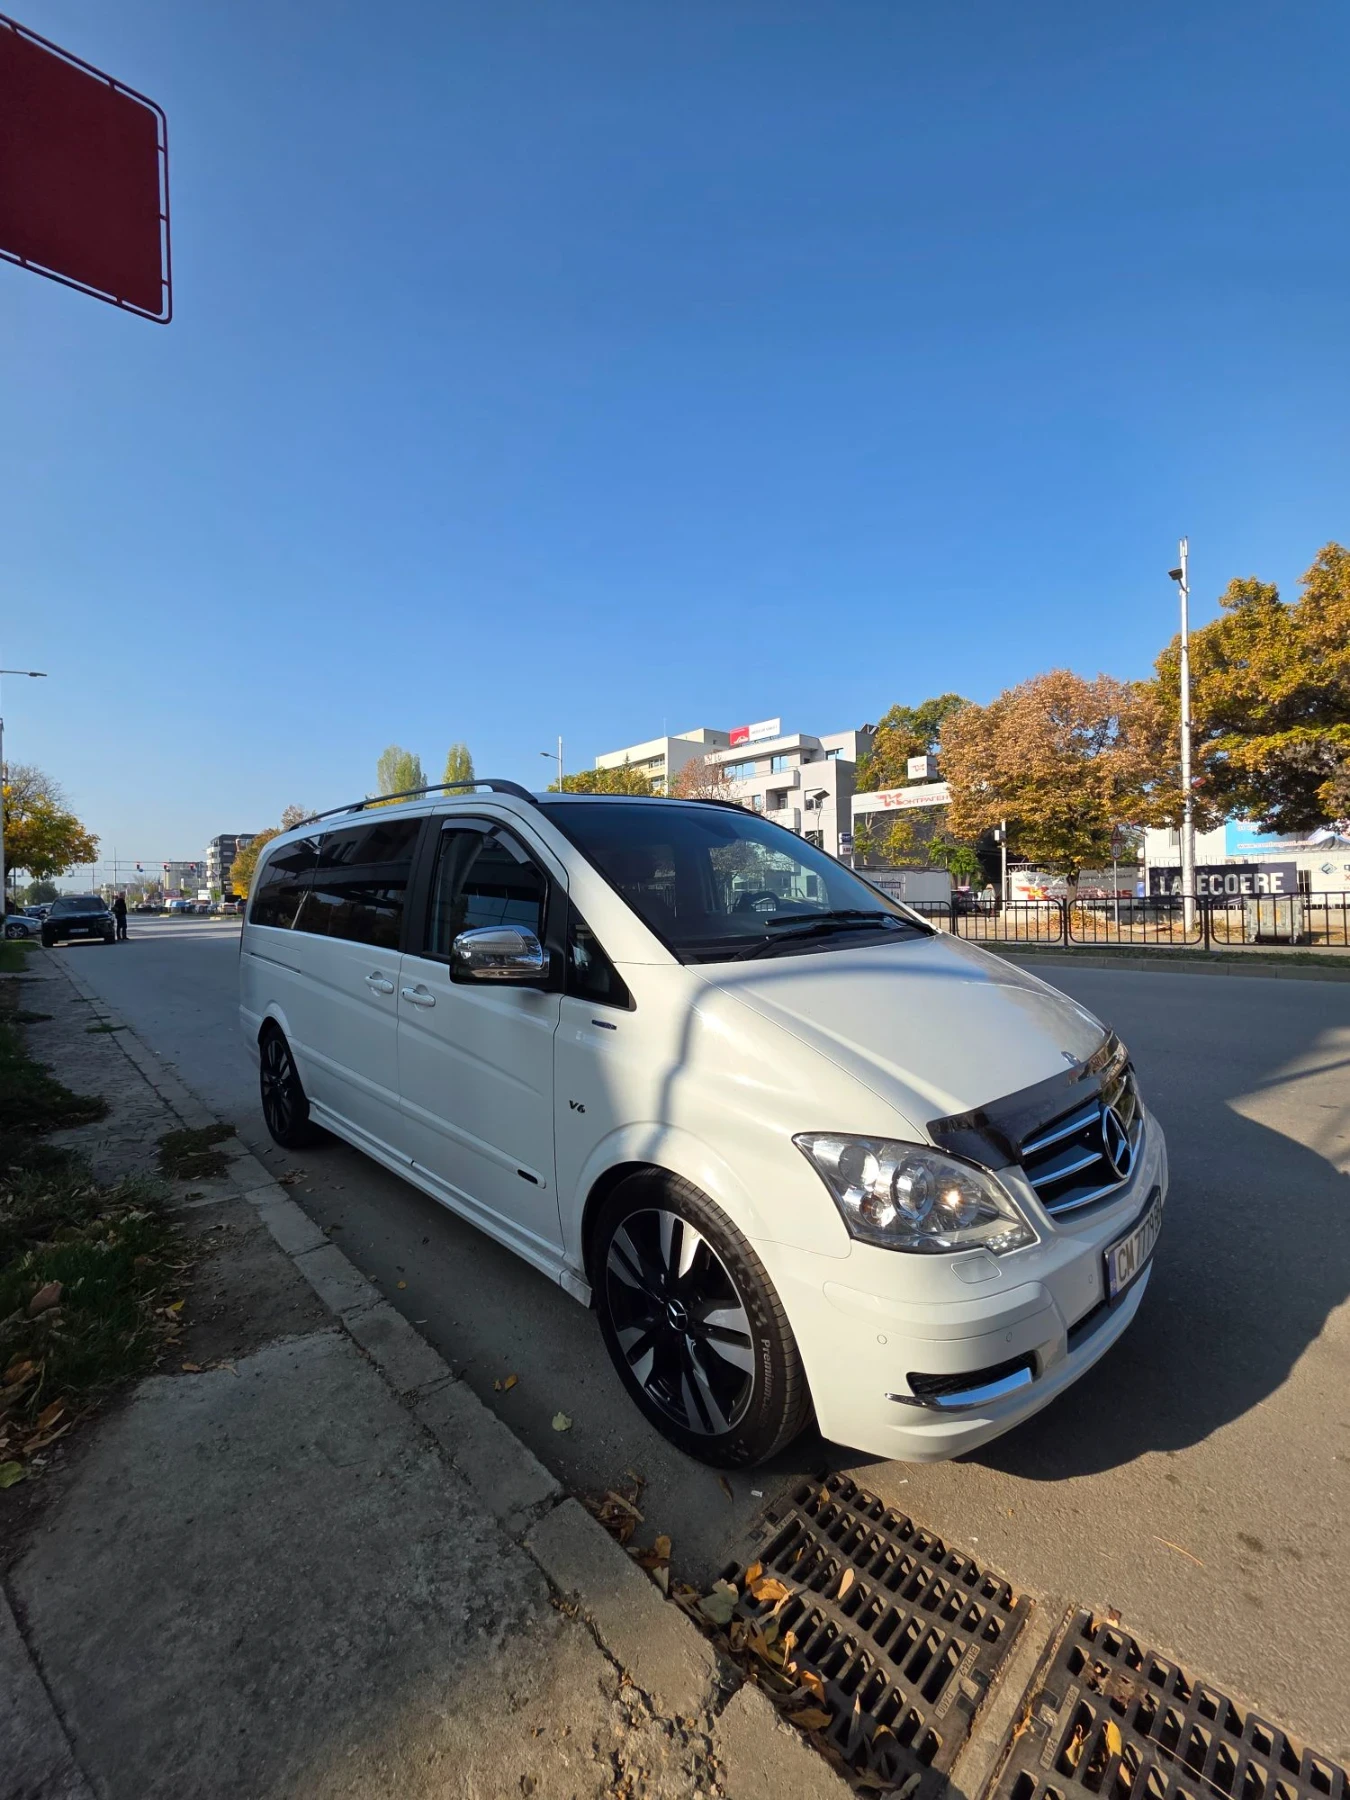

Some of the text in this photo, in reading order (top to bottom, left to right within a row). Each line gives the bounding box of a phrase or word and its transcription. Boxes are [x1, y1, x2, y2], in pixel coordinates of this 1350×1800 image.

[877, 793, 950, 806] КОНТРАГЕН
[1160, 872, 1284, 896] LAECOERE
[569, 1100, 585, 1113] V6
